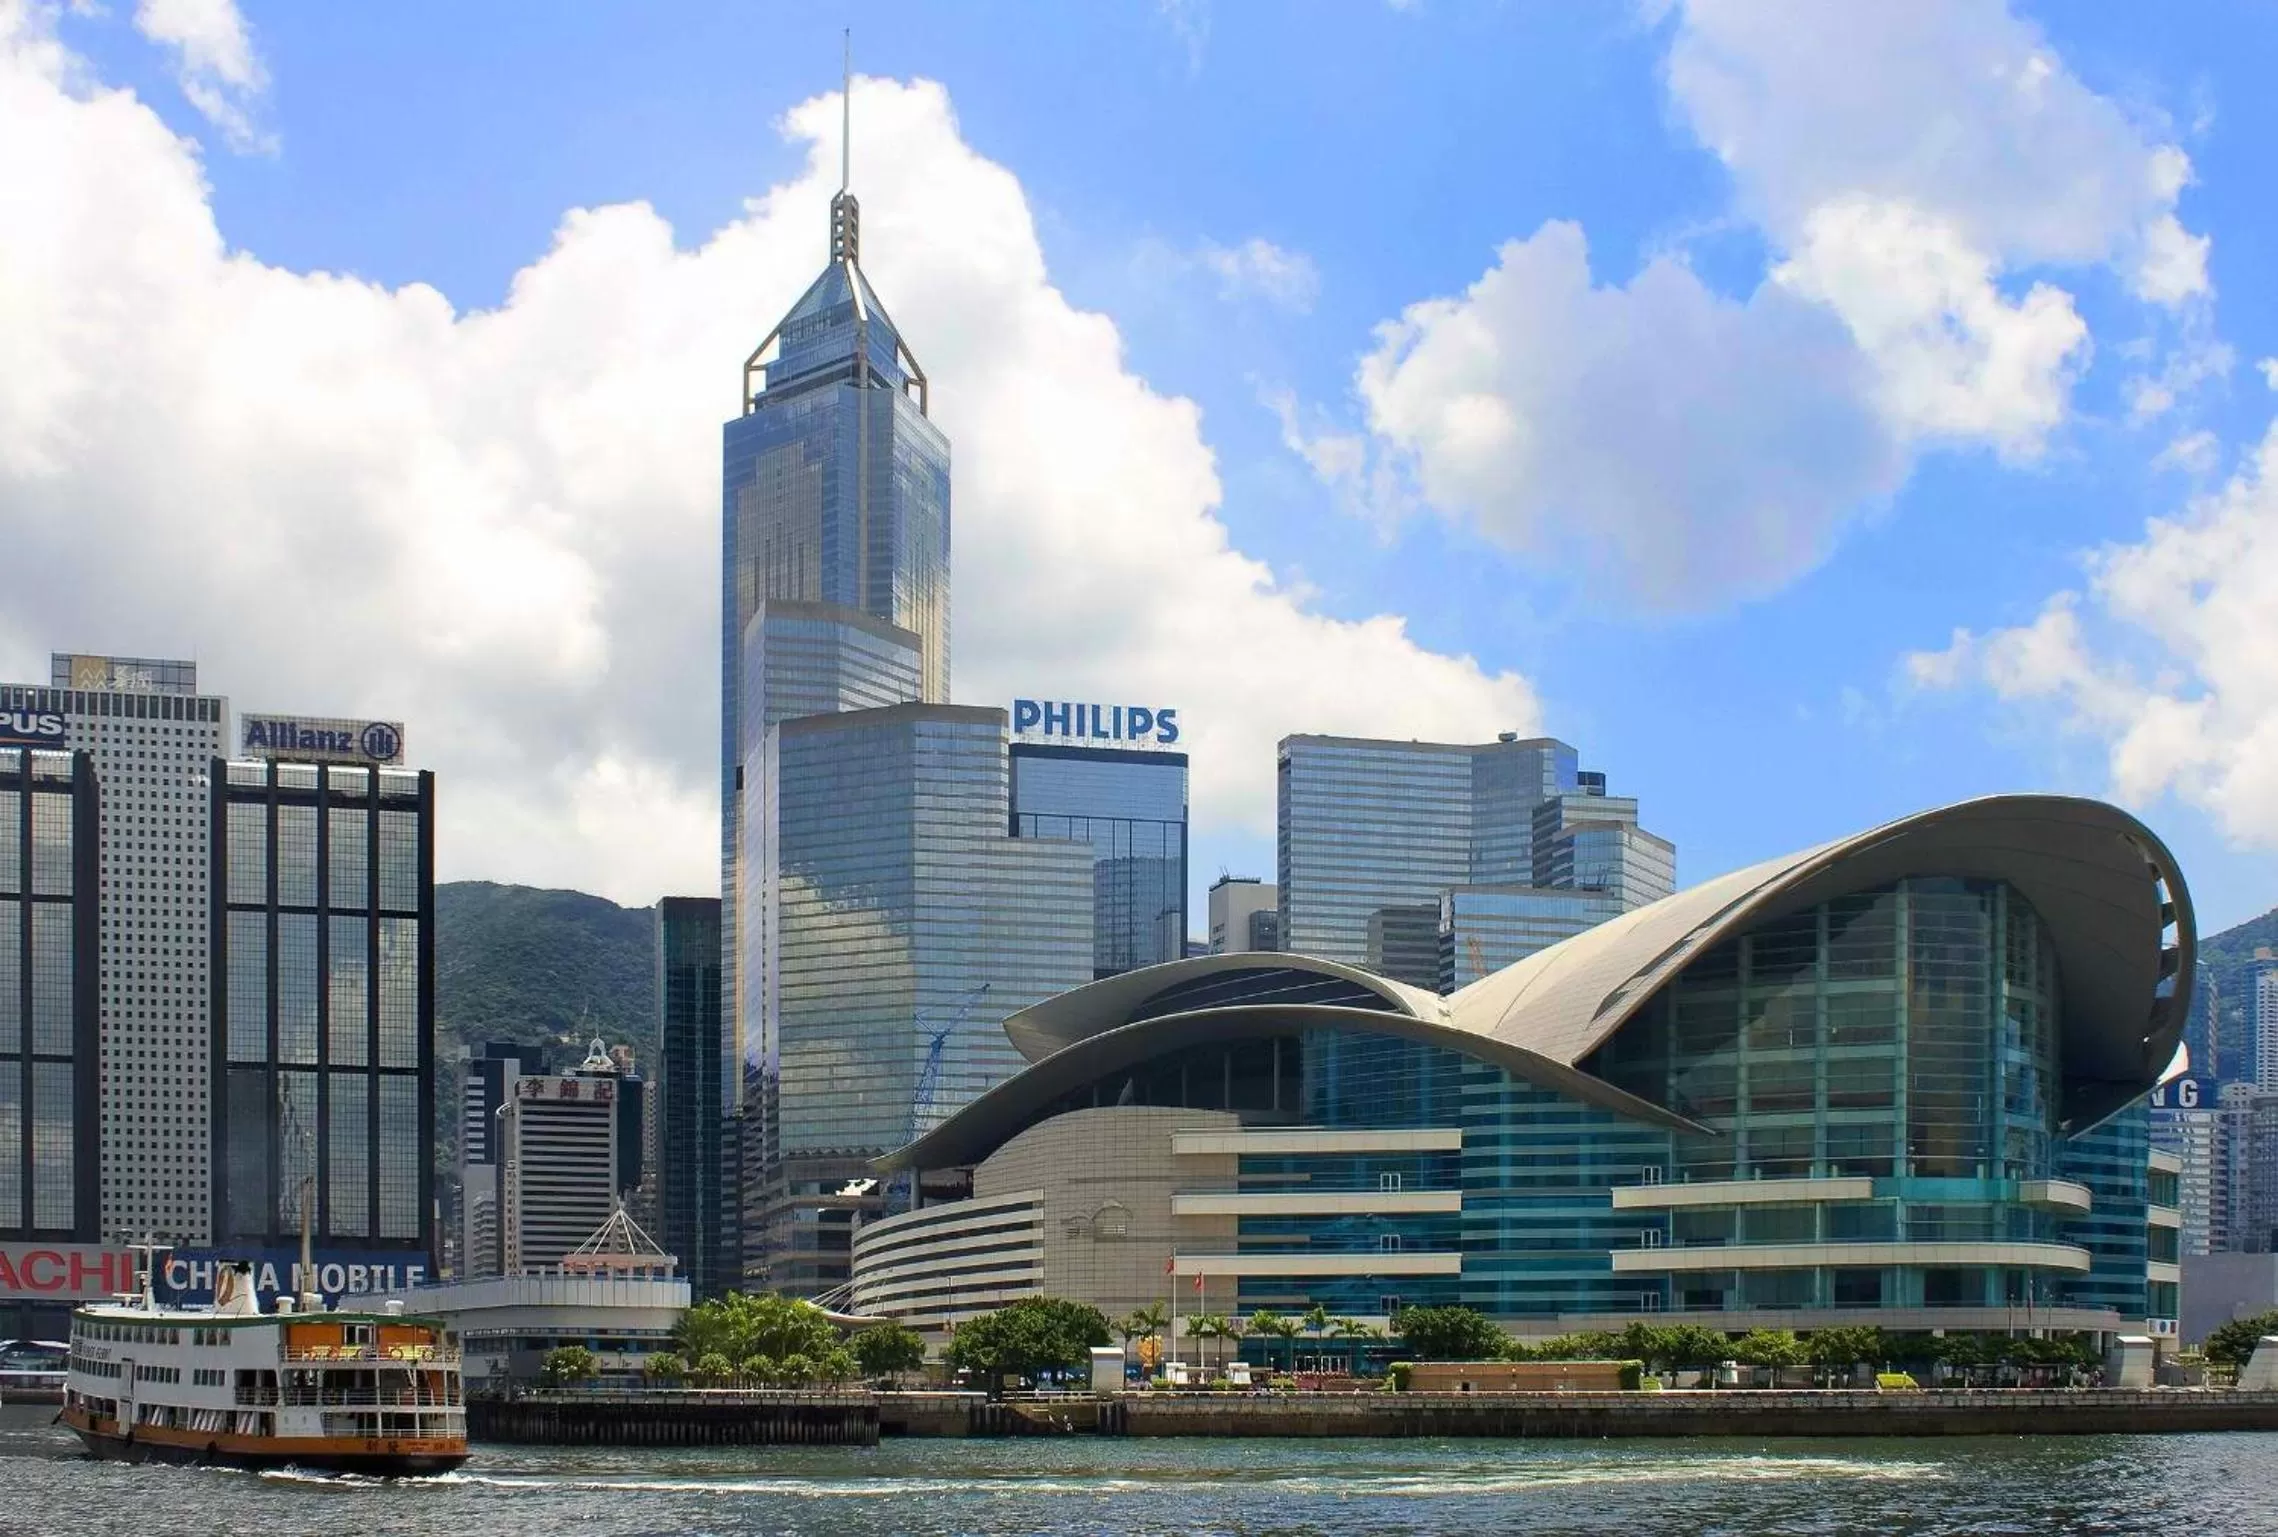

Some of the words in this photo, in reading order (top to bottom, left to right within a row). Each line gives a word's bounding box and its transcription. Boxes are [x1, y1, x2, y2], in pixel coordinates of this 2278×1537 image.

[247, 720, 353, 753] Allianz
[1014, 699, 1179, 743] PHILIPS
[166, 1259, 281, 1292] CHA
